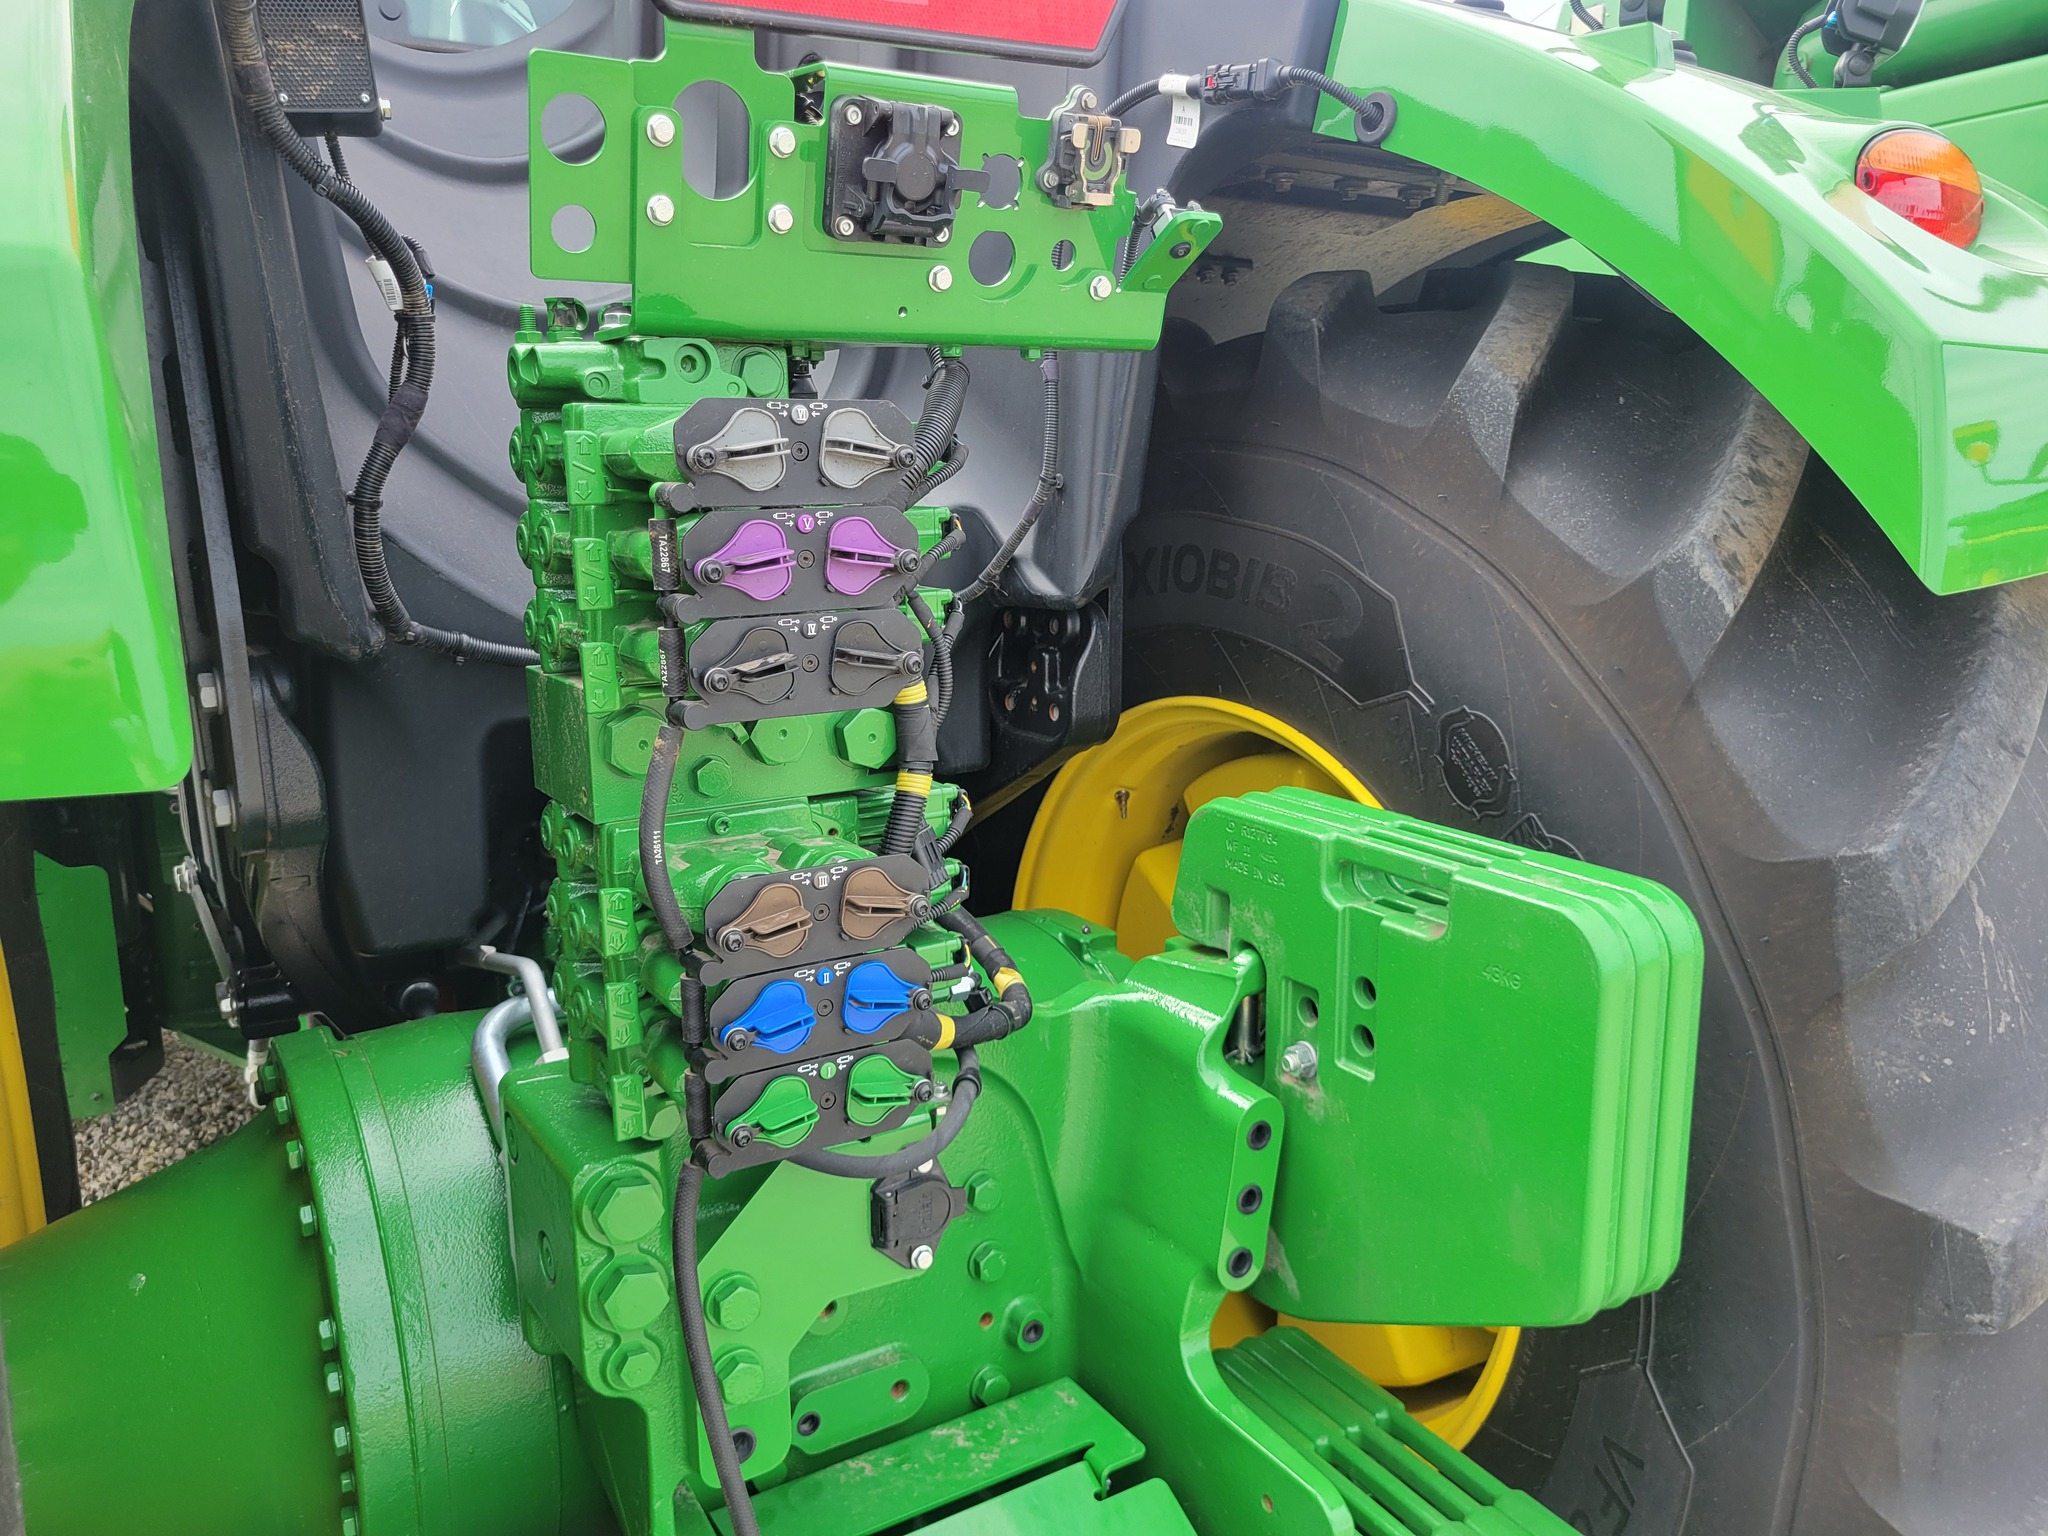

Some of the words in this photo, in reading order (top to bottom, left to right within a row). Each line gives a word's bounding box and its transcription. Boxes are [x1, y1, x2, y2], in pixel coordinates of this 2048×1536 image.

[802, 517, 812, 530] V
[658, 534, 671, 573] TA22867
[807, 623, 817, 635] IV
[653, 830, 663, 865] TA26111
[818, 875, 828, 888] III
[823, 972, 830, 984] II
